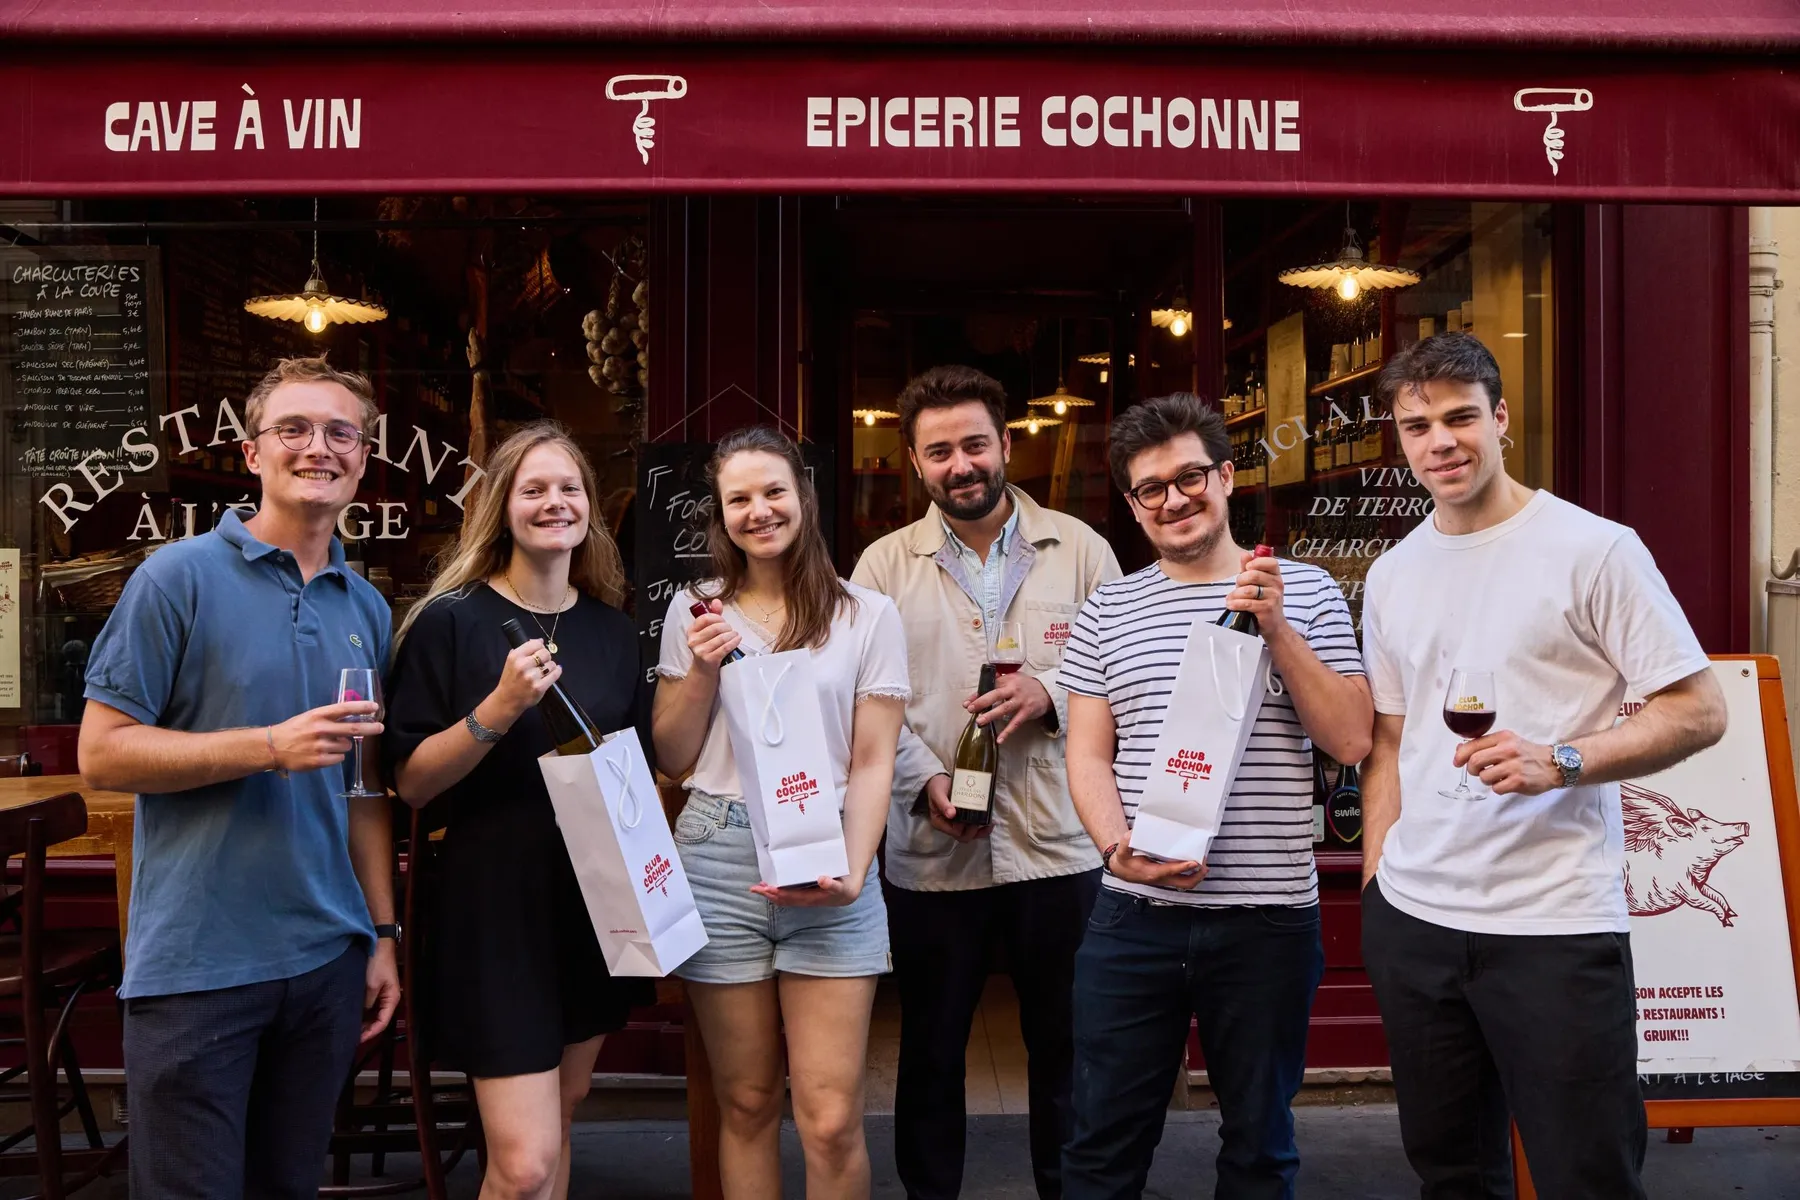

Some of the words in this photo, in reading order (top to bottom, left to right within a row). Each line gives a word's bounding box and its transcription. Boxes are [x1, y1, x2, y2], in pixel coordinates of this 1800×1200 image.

[105, 101, 216, 152] CAVE
[235, 83, 264, 150] À
[284, 98, 361, 150] VIN
[807, 96, 1020, 148] EPICERIE
[1042, 95, 1300, 152] COCHONNE
[55, 286, 74, 299] LA
[79, 282, 122, 298] COUPE
[21, 360, 57, 369] SAUCISSON
[1256, 414, 1320, 465] ICI,
[1325, 395, 1355, 431] À
[24, 446, 46, 464] PÂTÉ
[49, 446, 80, 463] CROÛTE
[38, 396, 488, 534] RESTAANT
[1359, 467, 1420, 487] VINS
[666, 490, 714, 522] FOR
[1307, 496, 1351, 517] DE
[1355, 496, 1435, 517] TERRO
[126, 492, 166, 541] À
[1291, 538, 1403, 558] CHARCU
[1050, 622, 1069, 632] CLUB
[1178, 749, 1205, 762] CLUB
[1167, 757, 1213, 775] COCHON
[776, 779, 817, 798] COCHON
[781, 771, 807, 787] CLUB
[1334, 806, 1361, 818] swile
[643, 858, 671, 888] COCHON
[644, 853, 662, 875] CLUB
[1635, 987, 1655, 999] SON
[1659, 986, 1703, 999] ACCEPTE
[1705, 986, 1724, 998] LES
[1643, 1008, 1718, 1020] RESTAURANTS
[1644, 1029, 1689, 1041] GRUIK!!!
